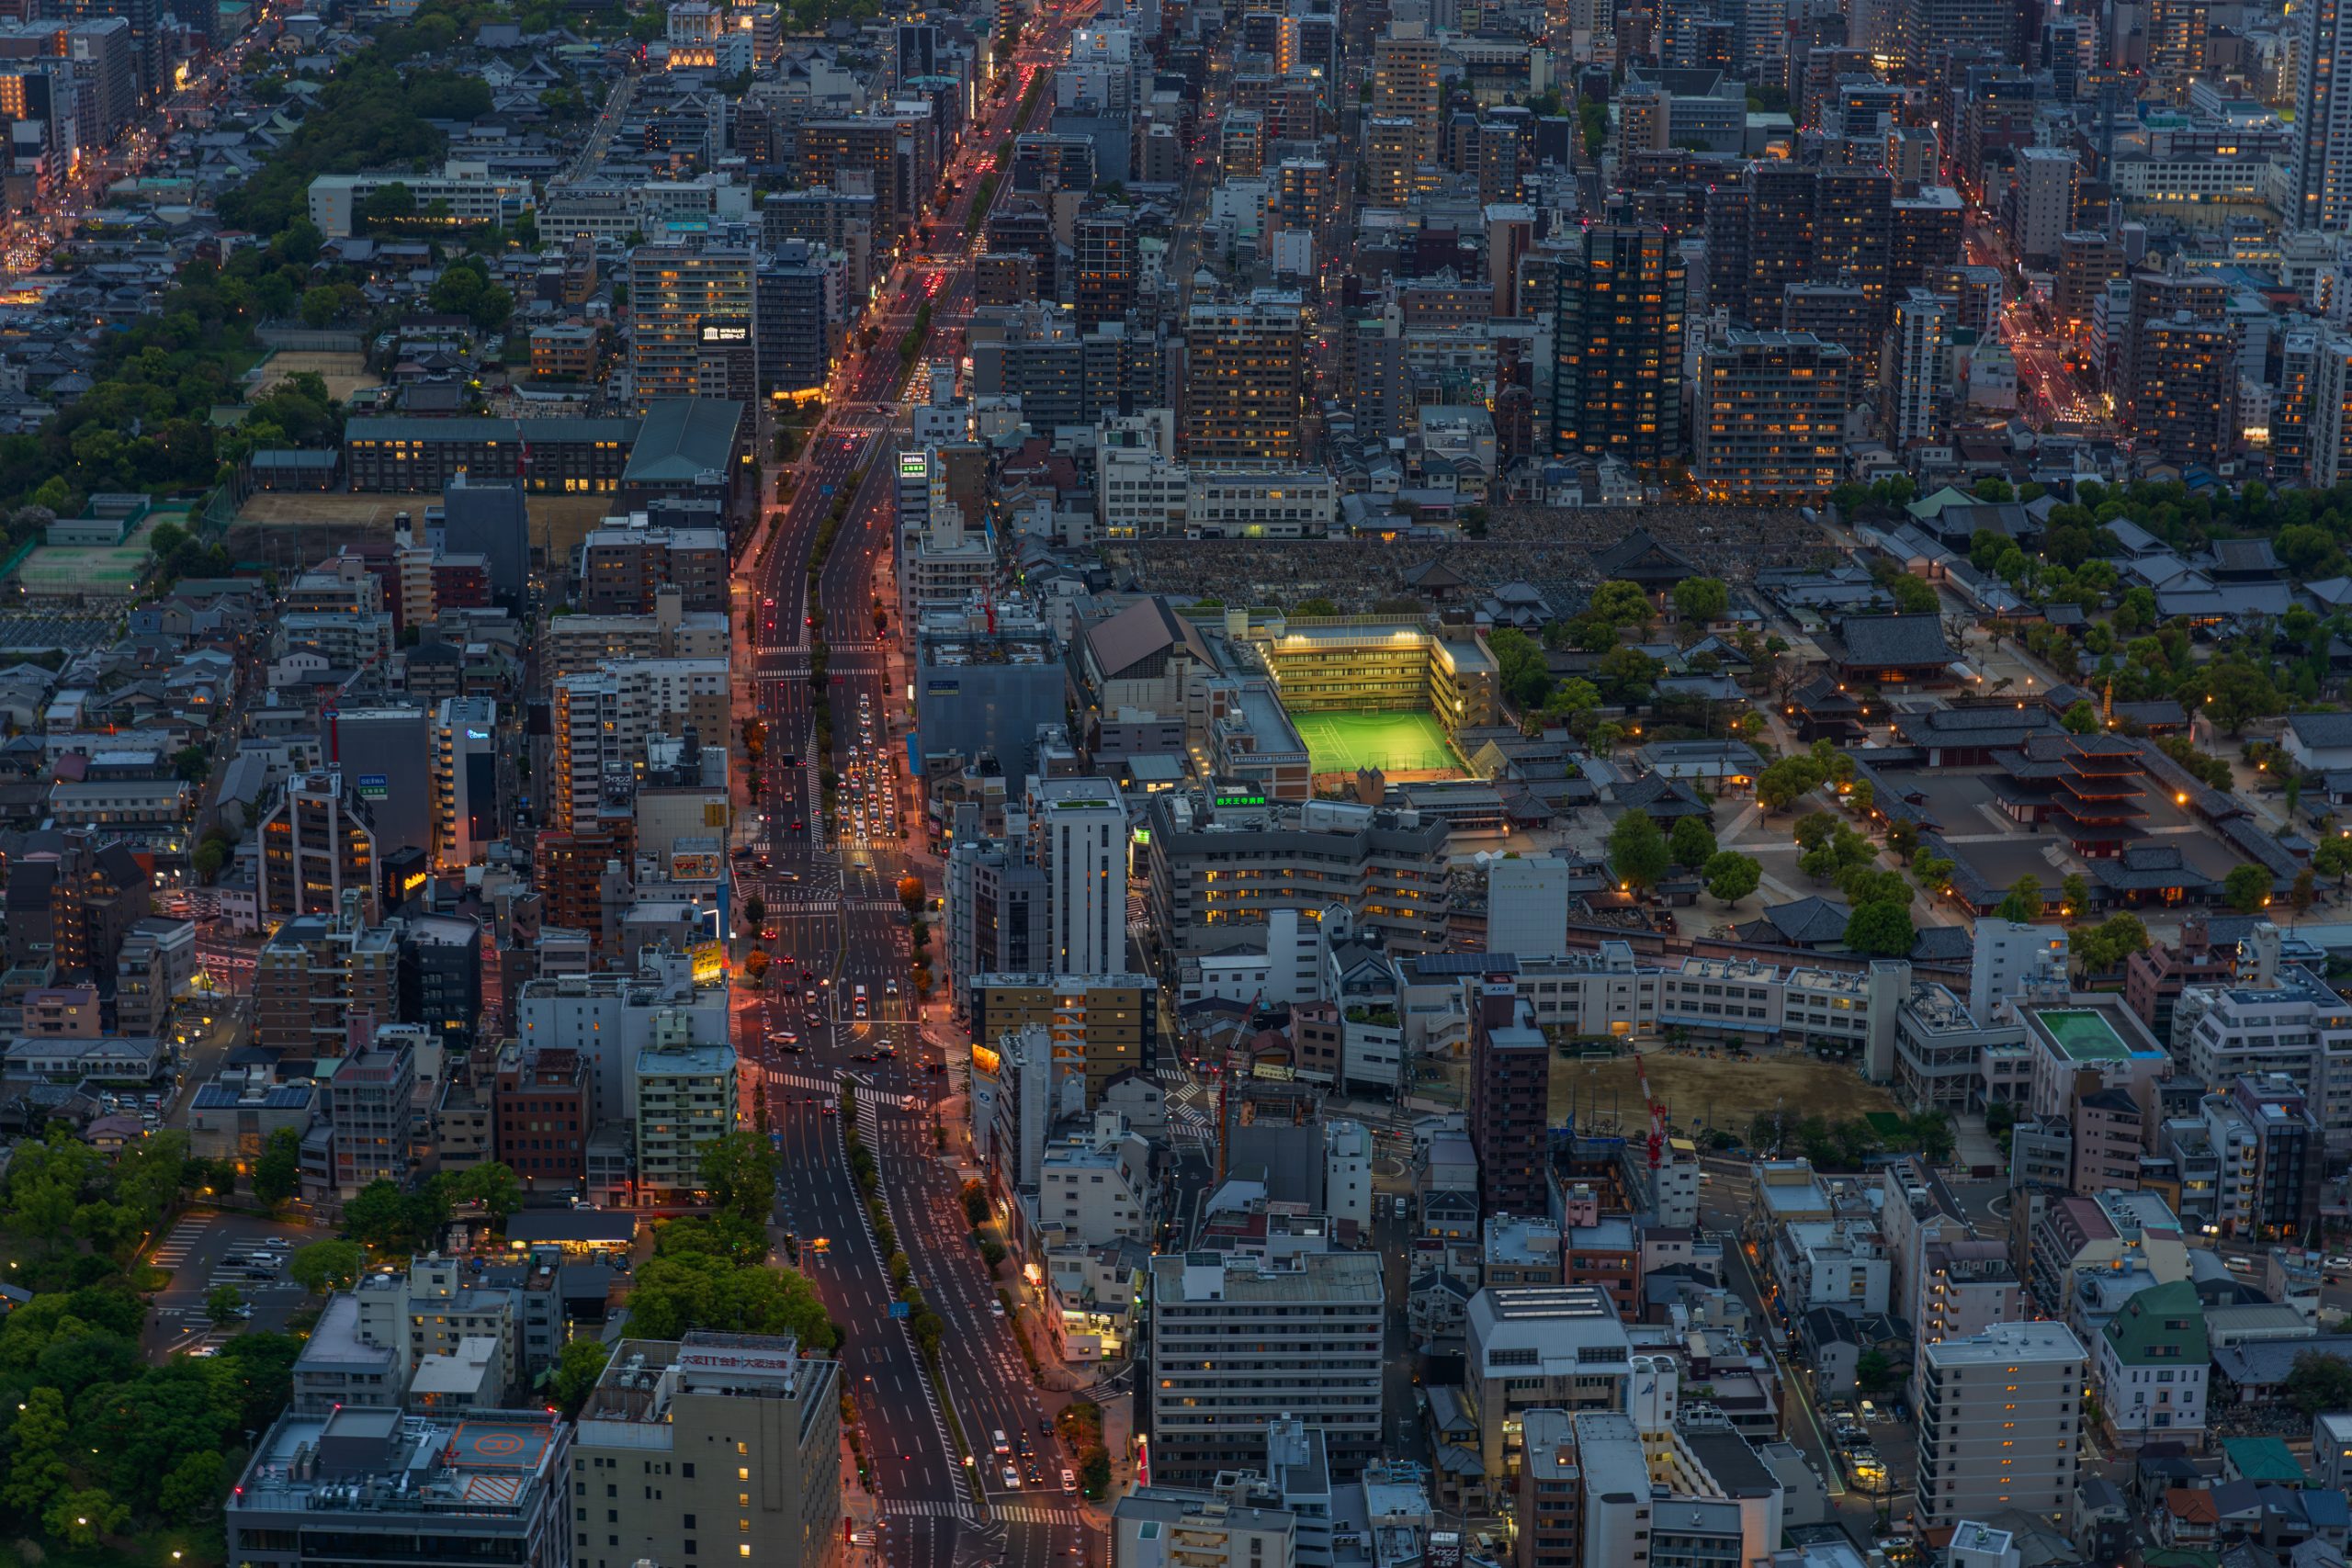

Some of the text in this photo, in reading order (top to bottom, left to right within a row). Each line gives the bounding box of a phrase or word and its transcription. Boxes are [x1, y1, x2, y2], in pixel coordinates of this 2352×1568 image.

[360, 777, 385, 785] SEIWA
[604, 774, 632, 784] ライオンズ
[1216, 796, 1265, 806] 四天王寺病院
[693, 953, 713, 962] ーパー
[698, 958, 721, 970] ホテル
[682, 1355, 787, 1369] 大阪IT会計 大阪法律
[1428, 1546, 1460, 1557] ライオンズ
